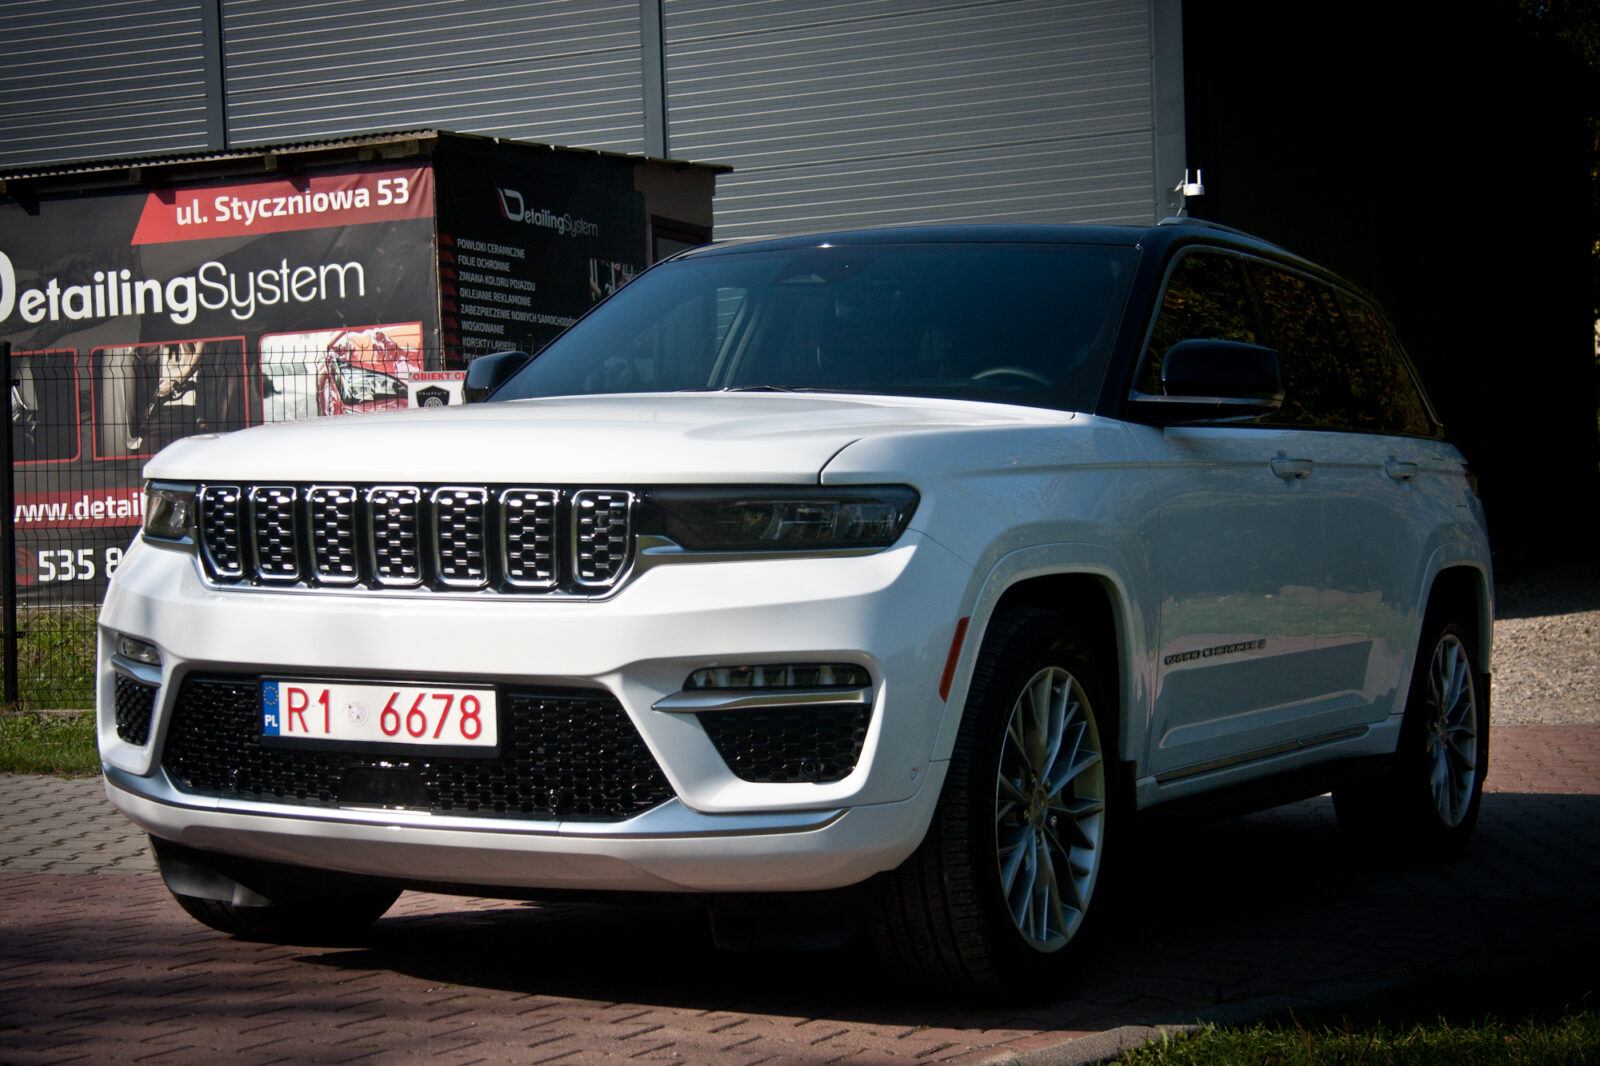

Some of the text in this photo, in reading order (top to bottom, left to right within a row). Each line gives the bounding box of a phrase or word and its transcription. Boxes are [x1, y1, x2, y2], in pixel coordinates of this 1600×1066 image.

[176, 177, 409, 226] ul. Styczniowa 53
[458, 255, 511, 272] FOLIE OCHRONNE
[485, 276, 509, 288] KOLORU
[461, 320, 505, 335] WOSKOWANIE
[412, 372, 451, 381] OBIEKT
[38, 549, 96, 582] 535
[264, 714, 279, 727] PL
[288, 687, 482, 740] R1 6678
